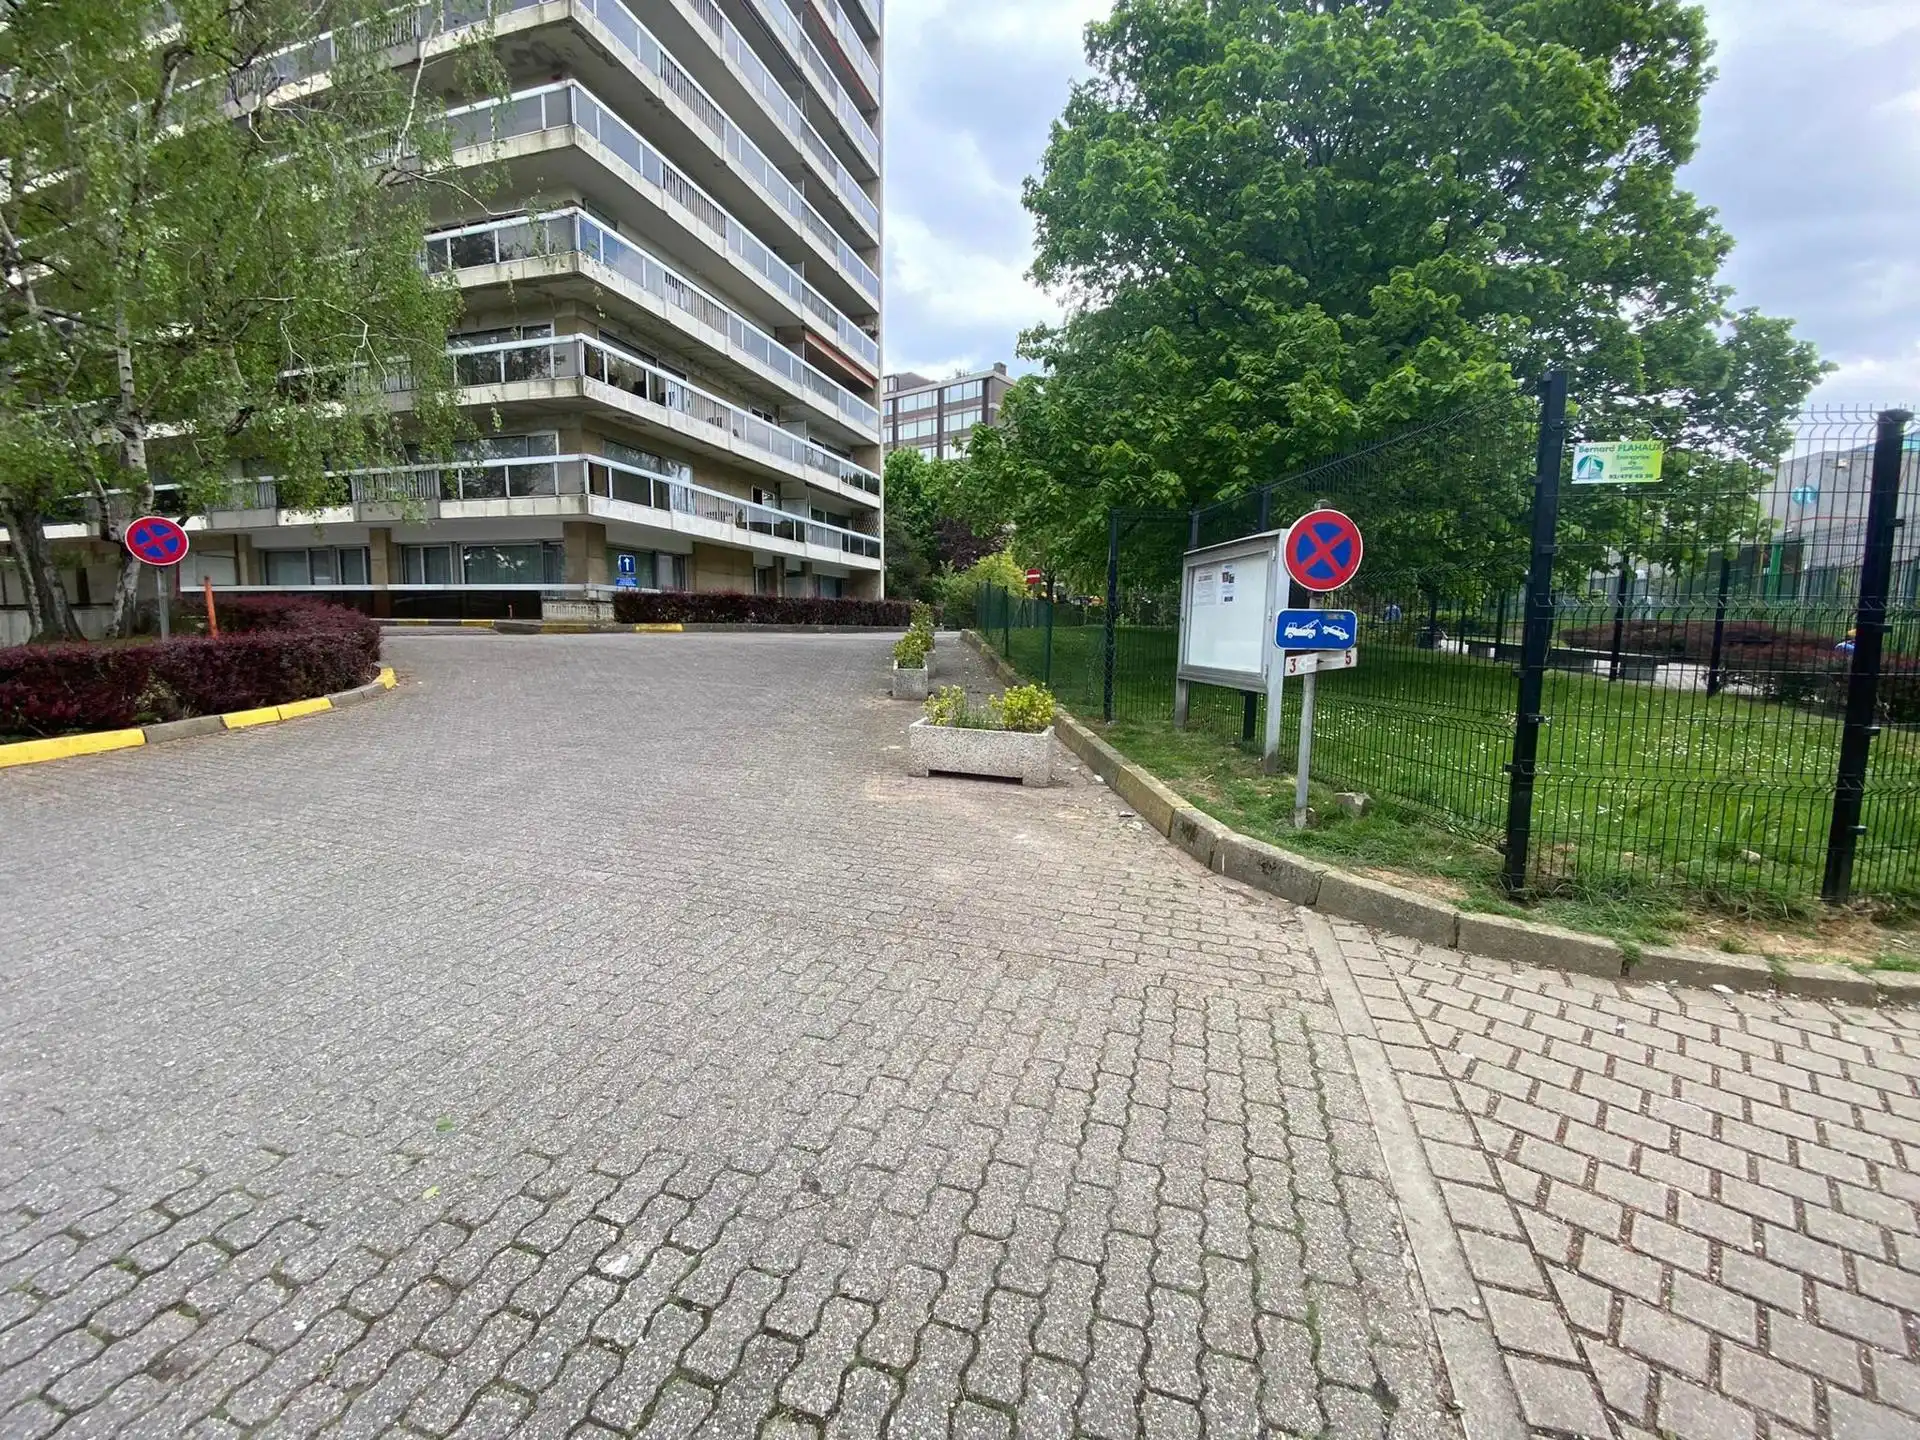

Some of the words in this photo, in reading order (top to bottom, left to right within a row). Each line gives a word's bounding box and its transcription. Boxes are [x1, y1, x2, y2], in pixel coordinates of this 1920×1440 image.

[1579, 445, 1615, 453] Bernard
[1289, 658, 1297, 673] 3
[1345, 650, 1352, 665] 5
